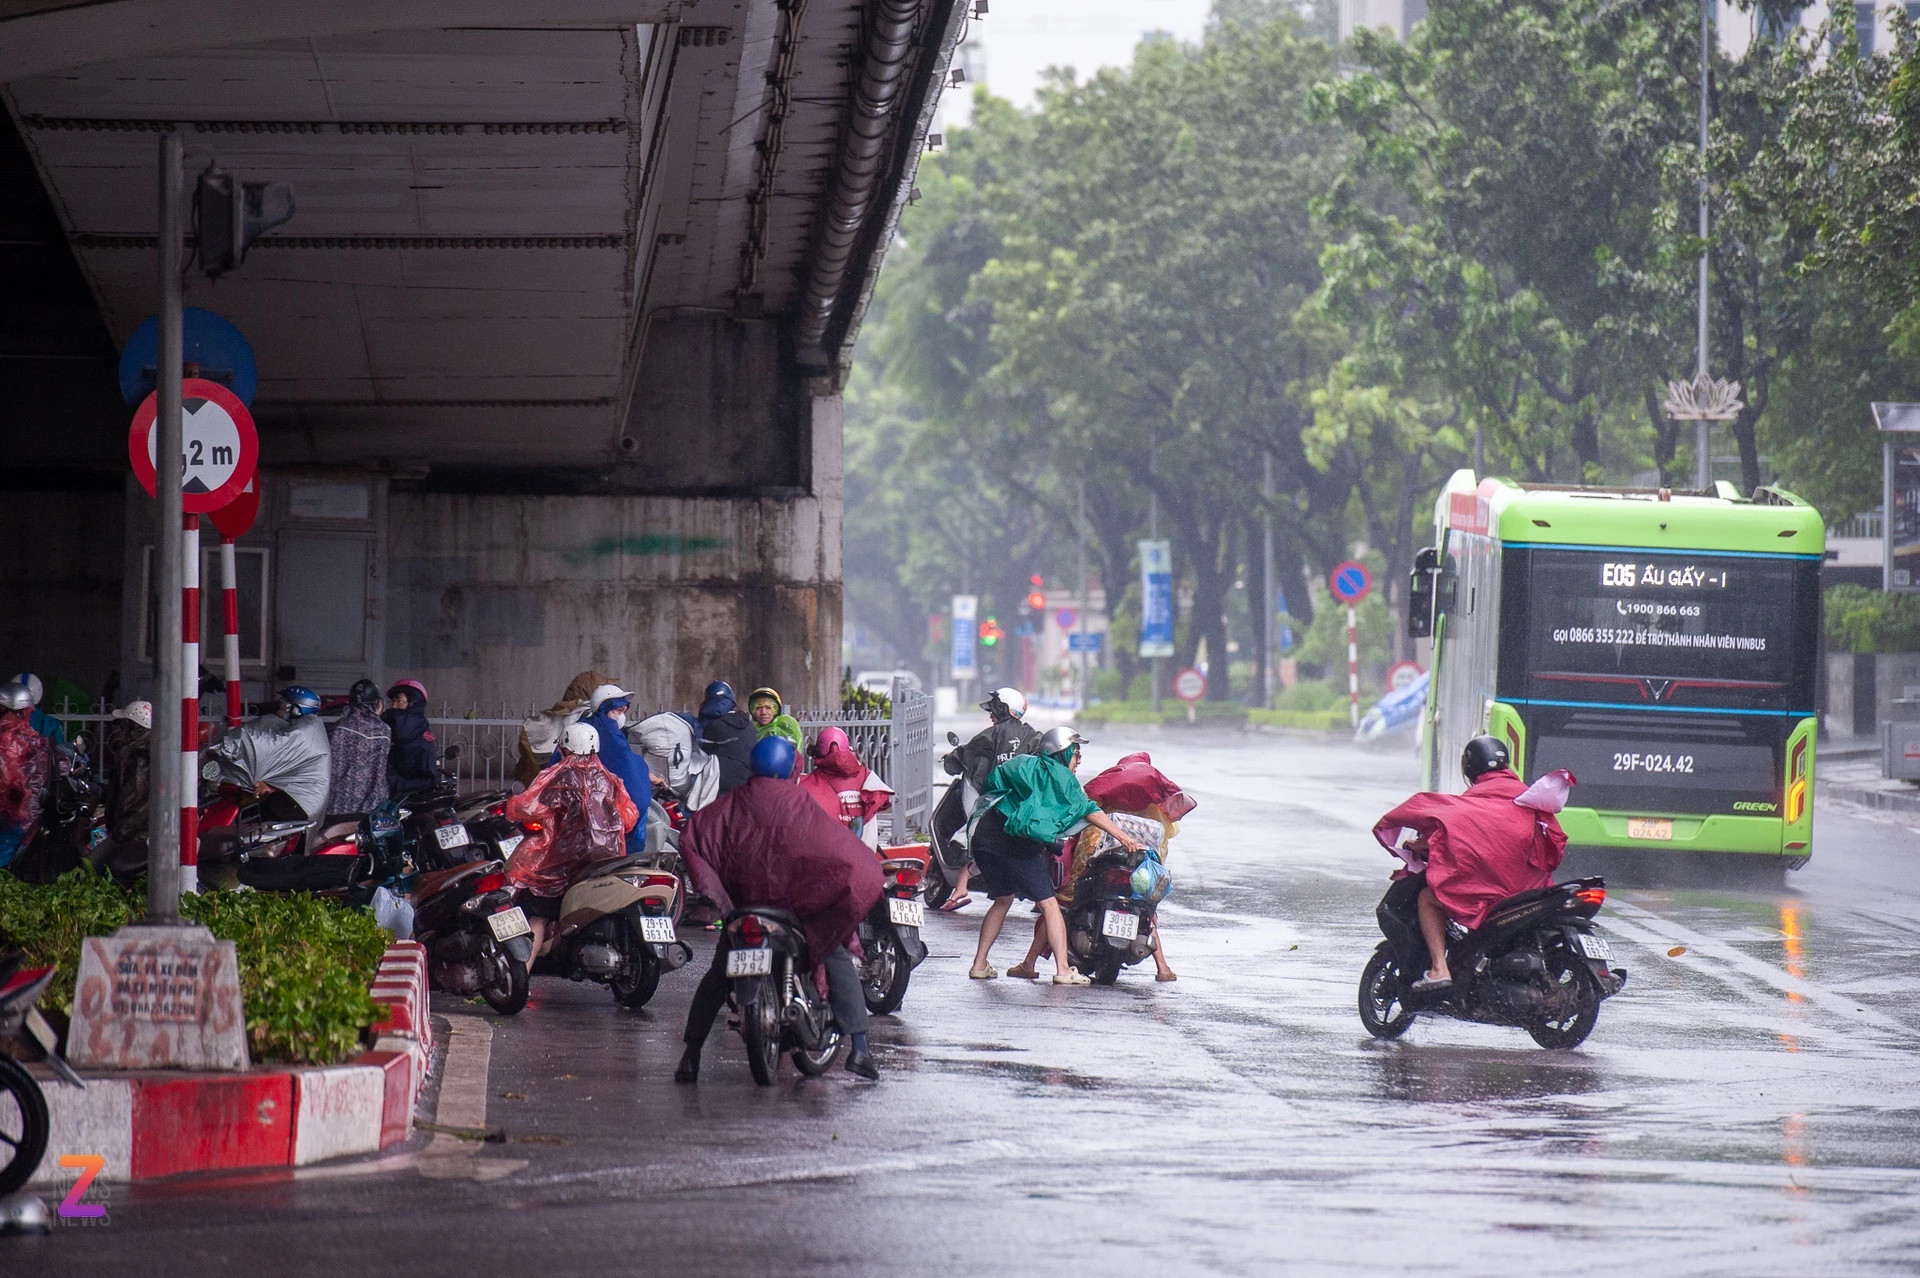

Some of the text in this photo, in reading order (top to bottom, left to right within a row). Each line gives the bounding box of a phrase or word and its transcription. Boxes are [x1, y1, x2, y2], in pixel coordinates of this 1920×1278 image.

[212, 445, 233, 466] m
[1603, 563, 1636, 587] E05
[1668, 565, 1705, 587] GIẤY
[1627, 603, 1700, 617] 1900 866 663
[1553, 629, 1568, 645] GỌI
[1569, 627, 1594, 642] 0866
[1595, 628, 1614, 643] 355
[1615, 629, 1634, 644] 222
[1664, 631, 1692, 647] THÀNH
[1693, 633, 1716, 648] NHÂN
[1717, 634, 1736, 649] VIÊN
[1736, 637, 1766, 650] VINBUS
[1613, 753, 1694, 773] 29F-024.42
[1733, 801, 1778, 811] GREEN
[645, 918, 669, 929] 29-F1
[1108, 924, 1132, 937] 5195
[645, 929, 674, 940] 363.14
